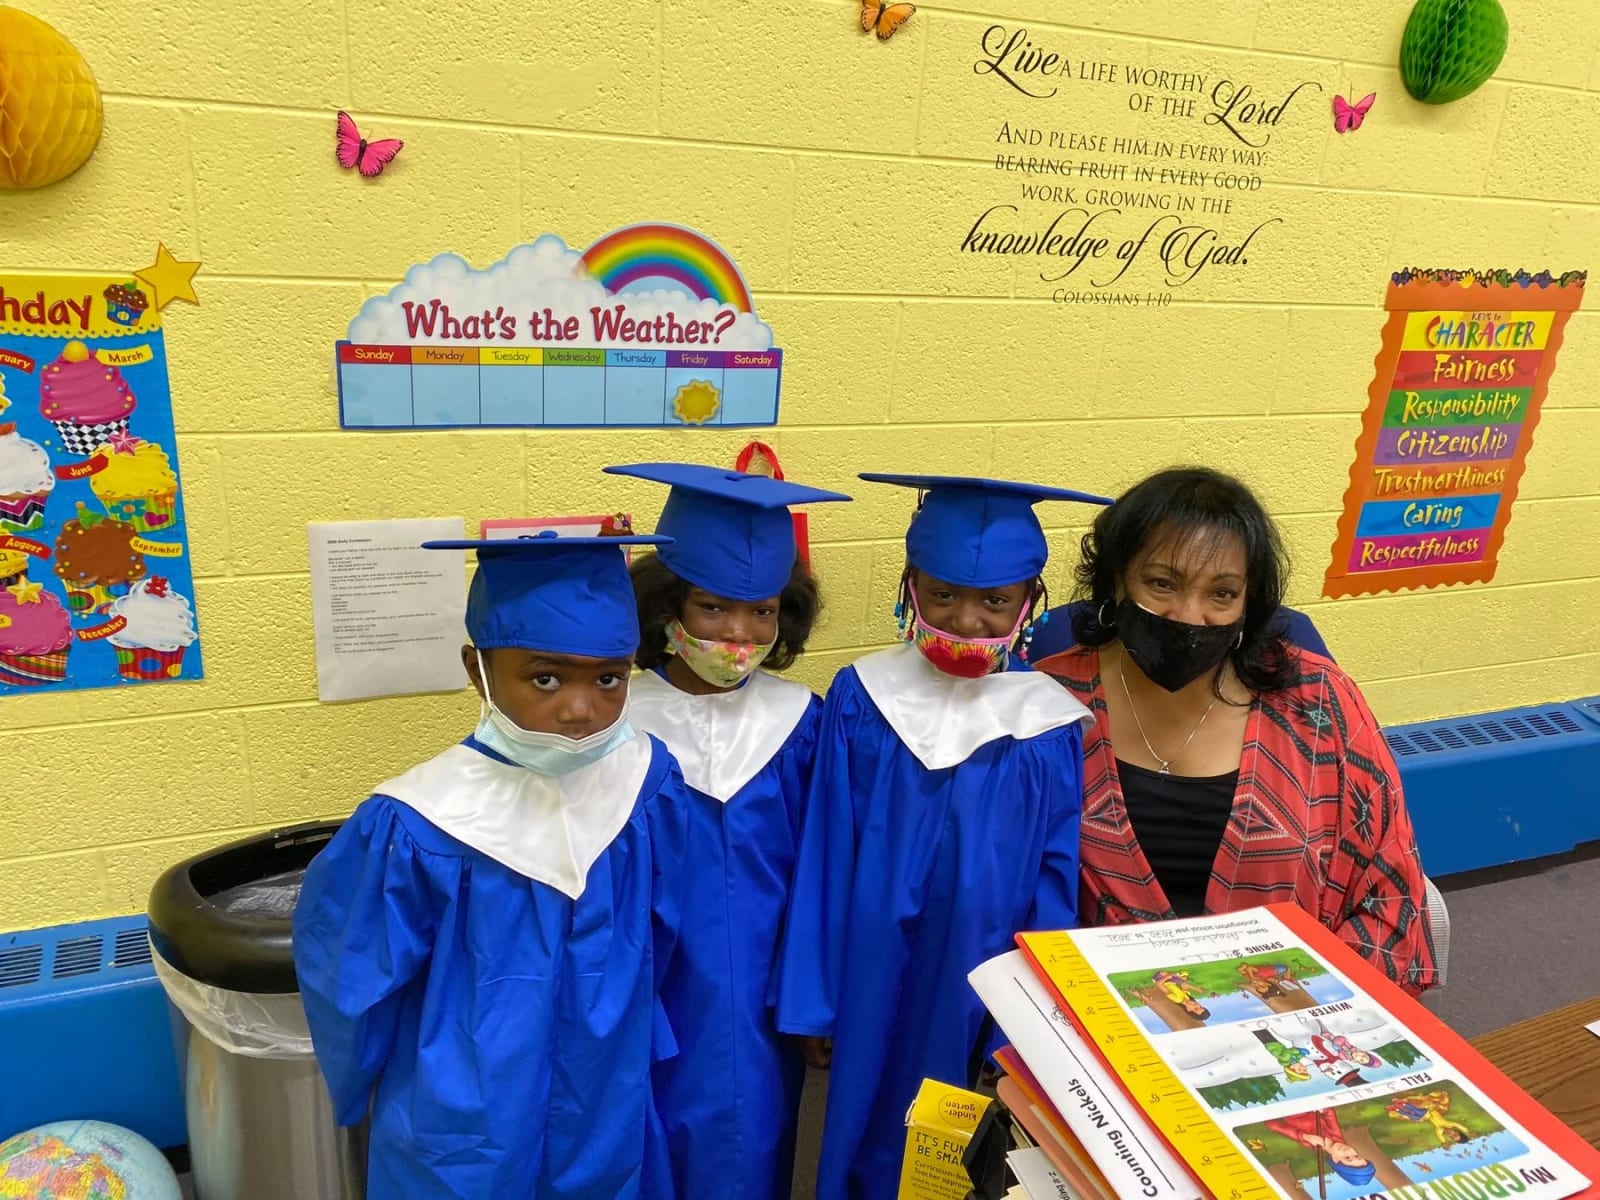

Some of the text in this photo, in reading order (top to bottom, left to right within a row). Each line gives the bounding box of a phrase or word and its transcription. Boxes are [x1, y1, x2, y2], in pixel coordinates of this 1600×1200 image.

[973, 25, 1208, 98] Live A LIFE WORTHY
[1128, 80, 1322, 148] OF THE Lord
[1048, 131, 1108, 153] PLEASE
[1112, 137, 1148, 156] HIM
[1154, 141, 1174, 158] IN
[1179, 143, 1229, 163] EVERY
[994, 154, 1262, 191] BEARING FRUIT IN EVERY GOOD
[1085, 188, 1172, 210] GROWING
[1176, 194, 1196, 212] IN
[1201, 197, 1233, 215] THE
[960, 205, 1284, 288] knowledge of God.
[1051, 288, 1172, 307] COLOSSIANS 1:10
[401, 298, 736, 344] What's the Weather?
[1425, 315, 1536, 349] CHARACTER
[107, 351, 144, 364] March
[354, 348, 773, 367] Sunday Monday Tuesday Wednesday Thursday Friday Saturday
[1432, 353, 1516, 383] Fairness
[1401, 391, 1521, 424] Responsibility
[1396, 426, 1508, 458] Citizenship
[69, 464, 93, 477] June
[1373, 466, 1506, 496] Trustworthiness
[1402, 503, 1463, 528] Caring
[4, 538, 44, 554] August
[132, 540, 181, 554] September
[1359, 535, 1480, 568] Respectfulness
[78, 617, 126, 641] December
[1244, 941, 1285, 954] SPRING
[1308, 1001, 1353, 1017] WINTER
[1400, 1072, 1434, 1087] FALL
[945, 1100, 976, 1112] garten
[915, 1132, 939, 1148] IT'S
[1068, 1077, 1159, 1198] Counting Nickels
[917, 1145, 965, 1167] BE SMA
[1518, 1166, 1558, 1185] My
